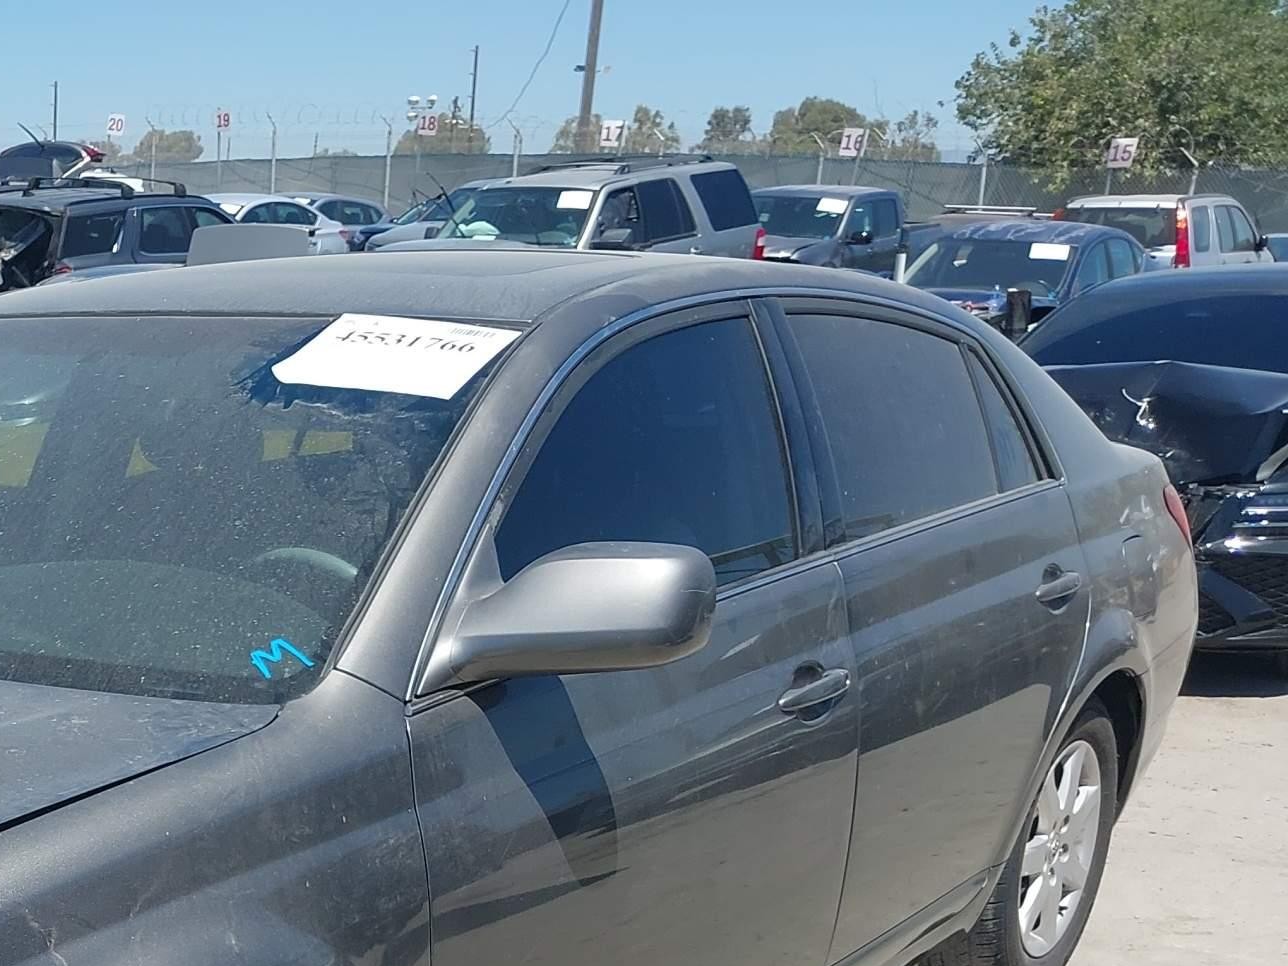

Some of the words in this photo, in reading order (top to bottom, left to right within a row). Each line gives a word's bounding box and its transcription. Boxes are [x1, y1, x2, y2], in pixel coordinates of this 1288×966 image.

[108, 117, 124, 132] 20
[216, 112, 230, 128] 19
[419, 115, 436, 131] 18
[602, 126, 624, 141] 17
[842, 134, 863, 151] 16
[1110, 144, 1133, 162] 15
[335, 329, 475, 353] 45531766
[250, 638, 315, 679] M
